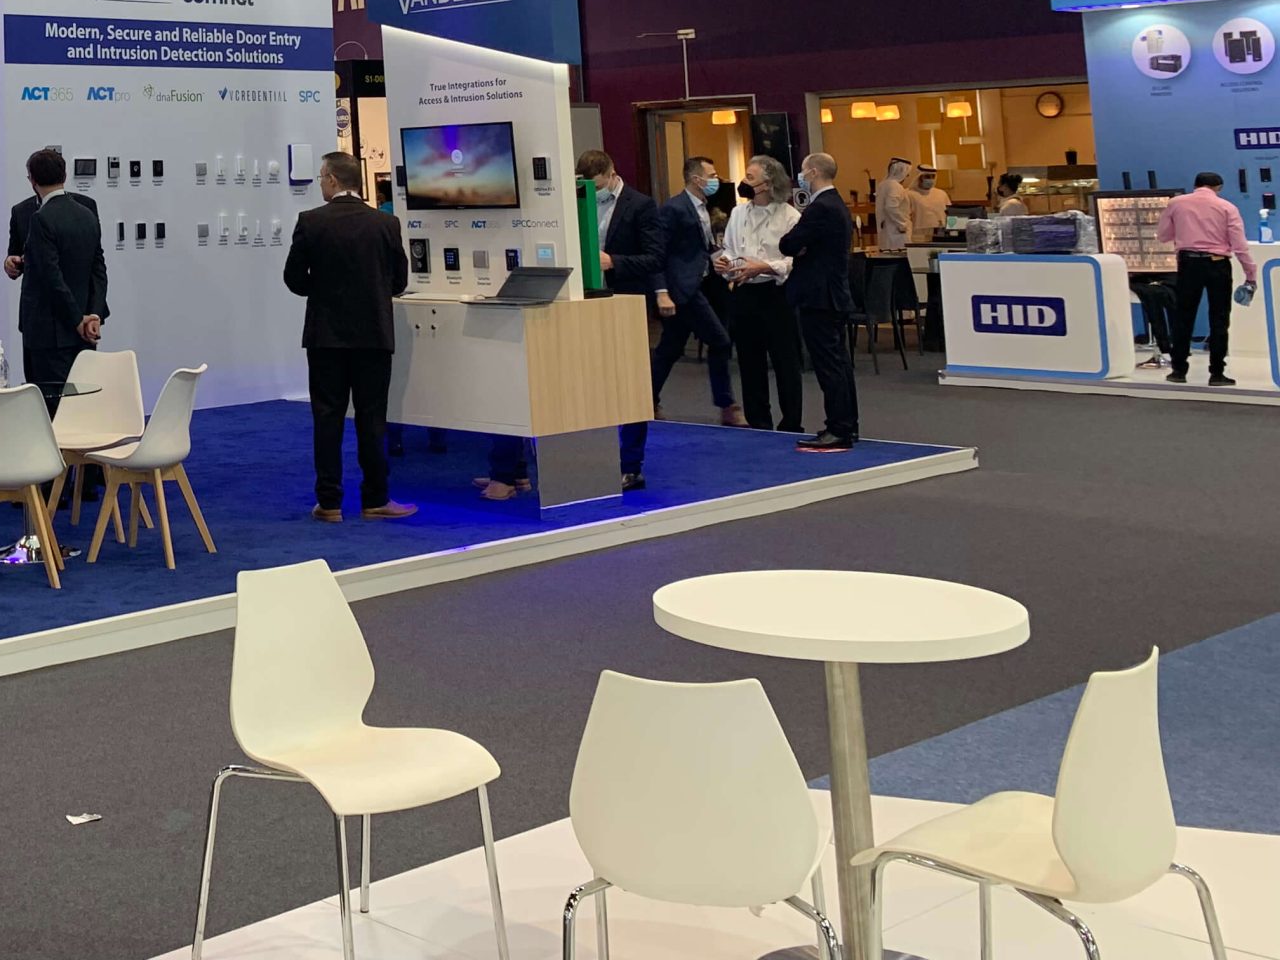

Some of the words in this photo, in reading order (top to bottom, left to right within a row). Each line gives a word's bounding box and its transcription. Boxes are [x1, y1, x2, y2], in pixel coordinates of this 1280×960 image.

[45, 22, 104, 41] Modern,
[107, 25, 152, 41] Secure
[155, 27, 179, 42] and
[183, 28, 234, 43] Reliable
[236, 30, 267, 45] Door
[269, 31, 301, 50] Entry
[67, 44, 93, 59] and
[97, 45, 158, 60] Intrusion
[161, 46, 223, 62] Detection
[226, 48, 284, 64] Solutions
[430, 83, 446, 91] True
[448, 80, 494, 91] Integrations
[495, 78, 506, 86] for
[299, 91, 320, 103] SPC
[419, 97, 442, 105] Access
[443, 95, 449, 103] &
[451, 94, 485, 103] Intrusion
[487, 91, 522, 100] Solutions
[444, 220, 459, 228] SPC
[979, 303, 1057, 327] HID
